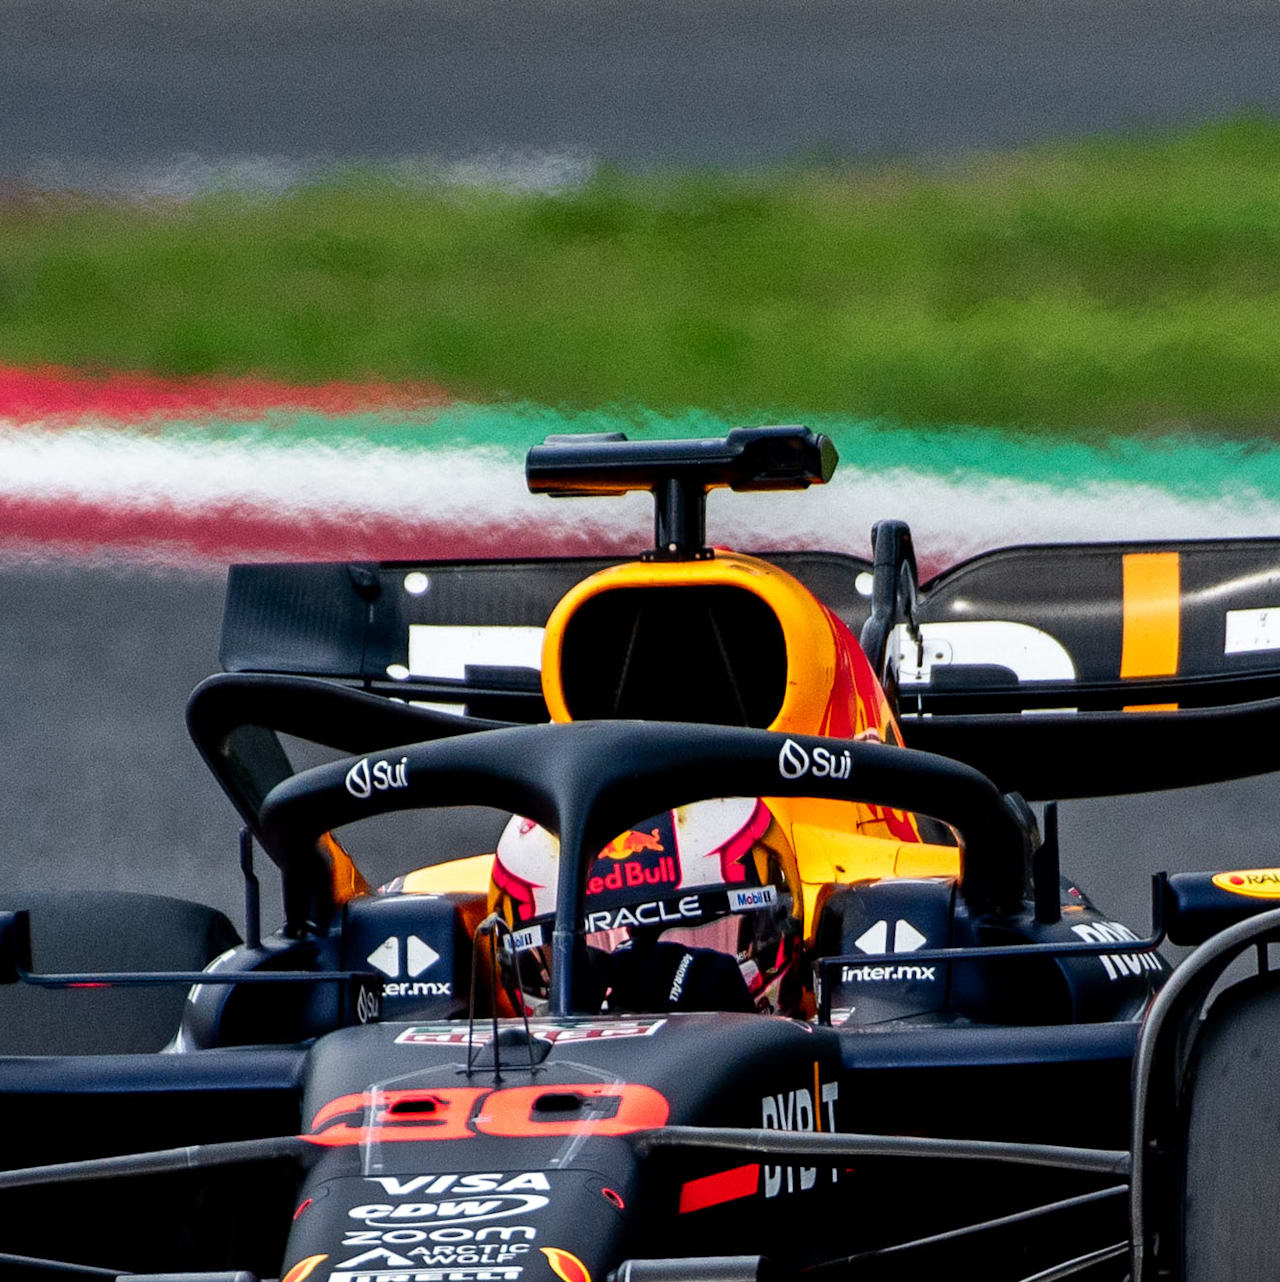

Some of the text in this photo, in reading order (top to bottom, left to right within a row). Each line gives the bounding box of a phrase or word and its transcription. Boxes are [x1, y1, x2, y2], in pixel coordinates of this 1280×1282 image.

[373, 757, 408, 790] Sui
[811, 747, 851, 779] Sui
[586, 856, 676, 895] ed Bull
[585, 895, 702, 932] RACLE
[841, 965, 937, 983] inter.mx
[381, 982, 451, 996] er.mx
[364, 1172, 551, 1195] VISA
[347, 1199, 504, 1220] CDW
[341, 1226, 537, 1246] zoom
[408, 1243, 531, 1255] ARCTIC
[421, 1253, 517, 1265] WOLF
